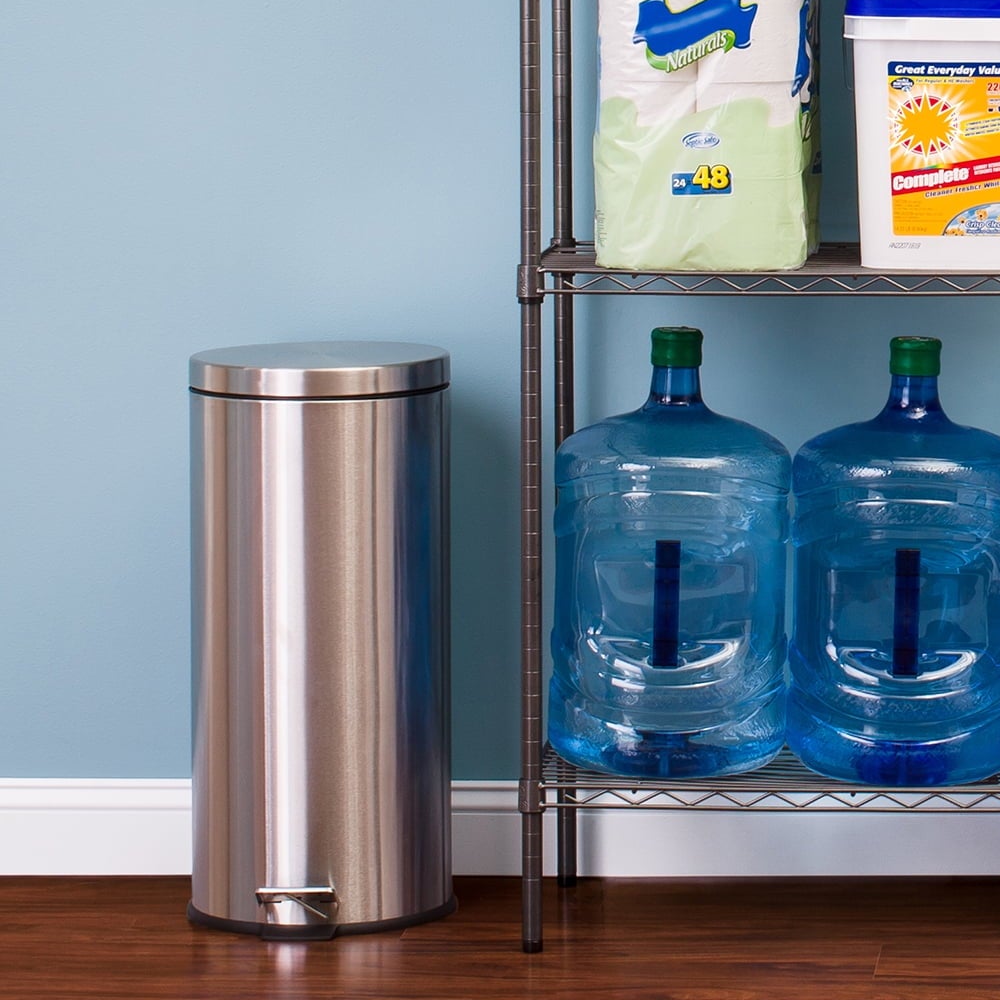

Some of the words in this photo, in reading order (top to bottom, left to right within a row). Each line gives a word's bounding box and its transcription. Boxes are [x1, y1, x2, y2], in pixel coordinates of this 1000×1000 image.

[666, 31, 728, 73] Naturals
[895, 65, 926, 74] Great
[927, 65, 976, 76] Everyday
[692, 164, 730, 189] 48
[893, 168, 969, 191] Complete
[673, 178, 686, 187] 24
[925, 188, 953, 198] Cleaner
[966, 220, 985, 230] Crisp
